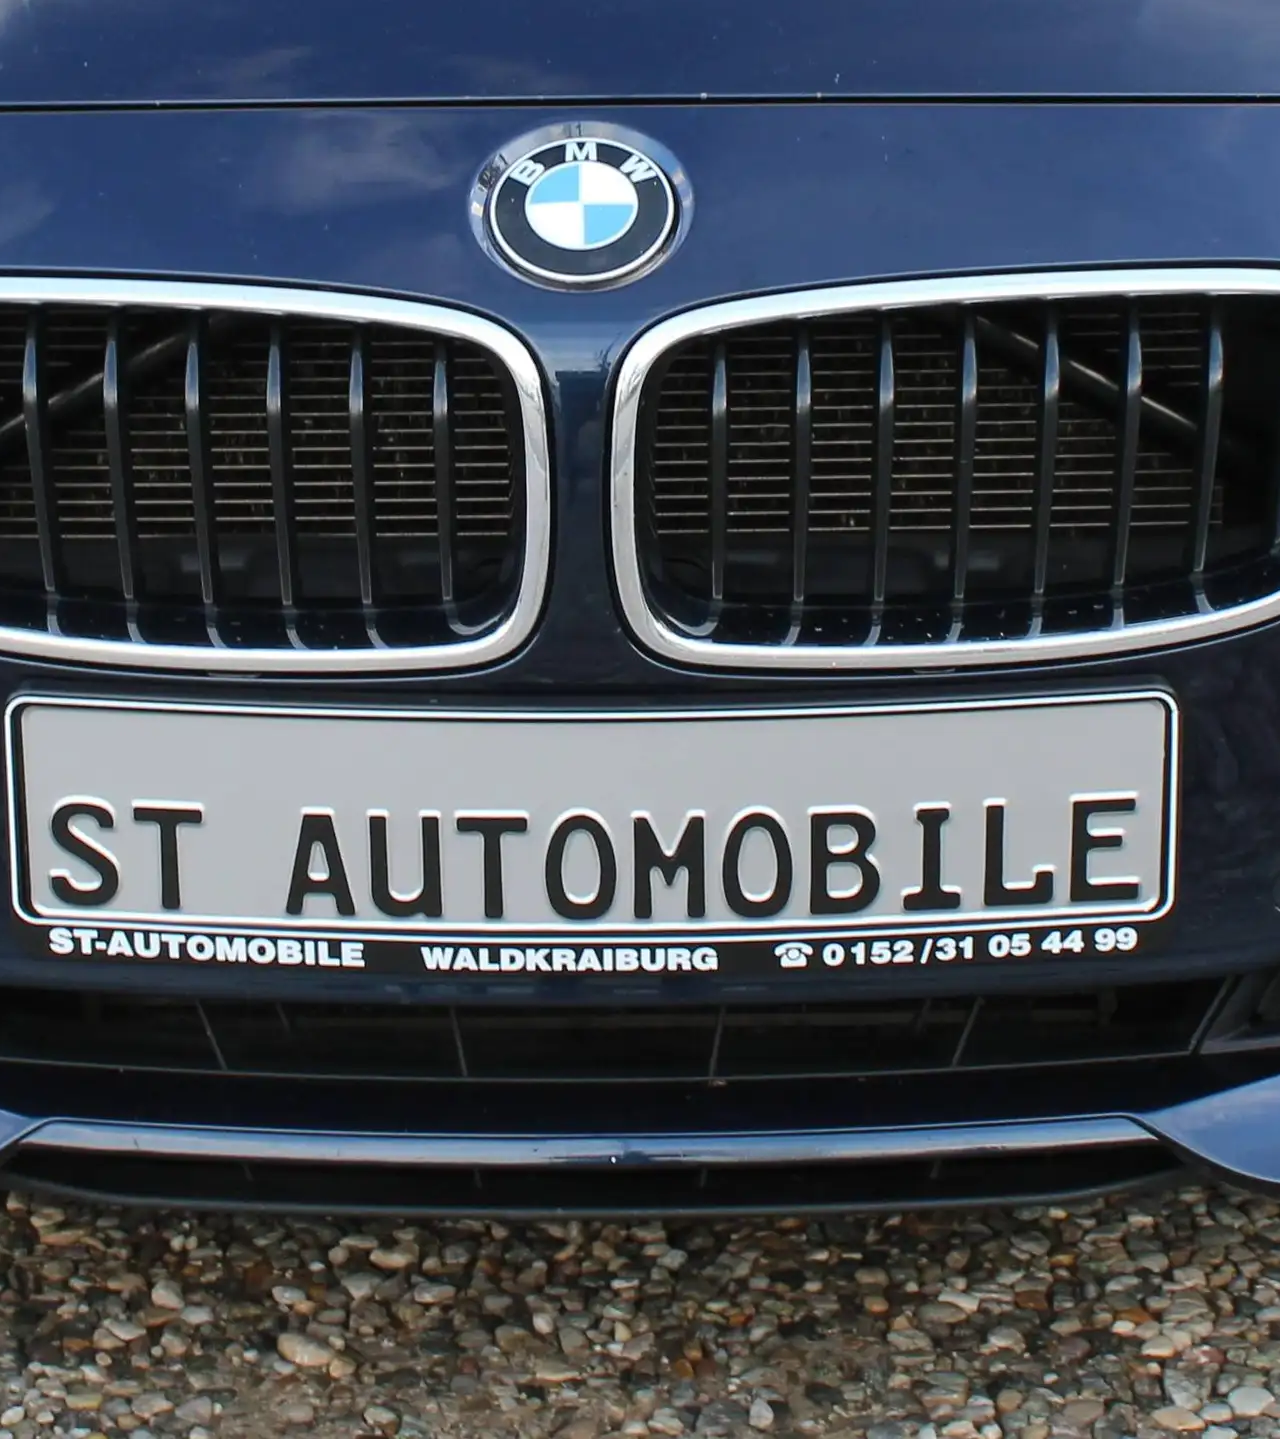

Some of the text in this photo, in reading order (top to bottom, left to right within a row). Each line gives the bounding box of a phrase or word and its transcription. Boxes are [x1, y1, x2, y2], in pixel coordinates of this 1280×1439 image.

[508, 140, 658, 187] BMW
[49, 792, 1141, 920] ST AUTOMOBILE
[48, 926, 366, 968] ST-AUTOMOBILE
[420, 945, 719, 972] WALDKRAIBURG
[988, 932, 1032, 959] 05
[1040, 928, 1086, 955] 44
[1093, 925, 1138, 952] 99
